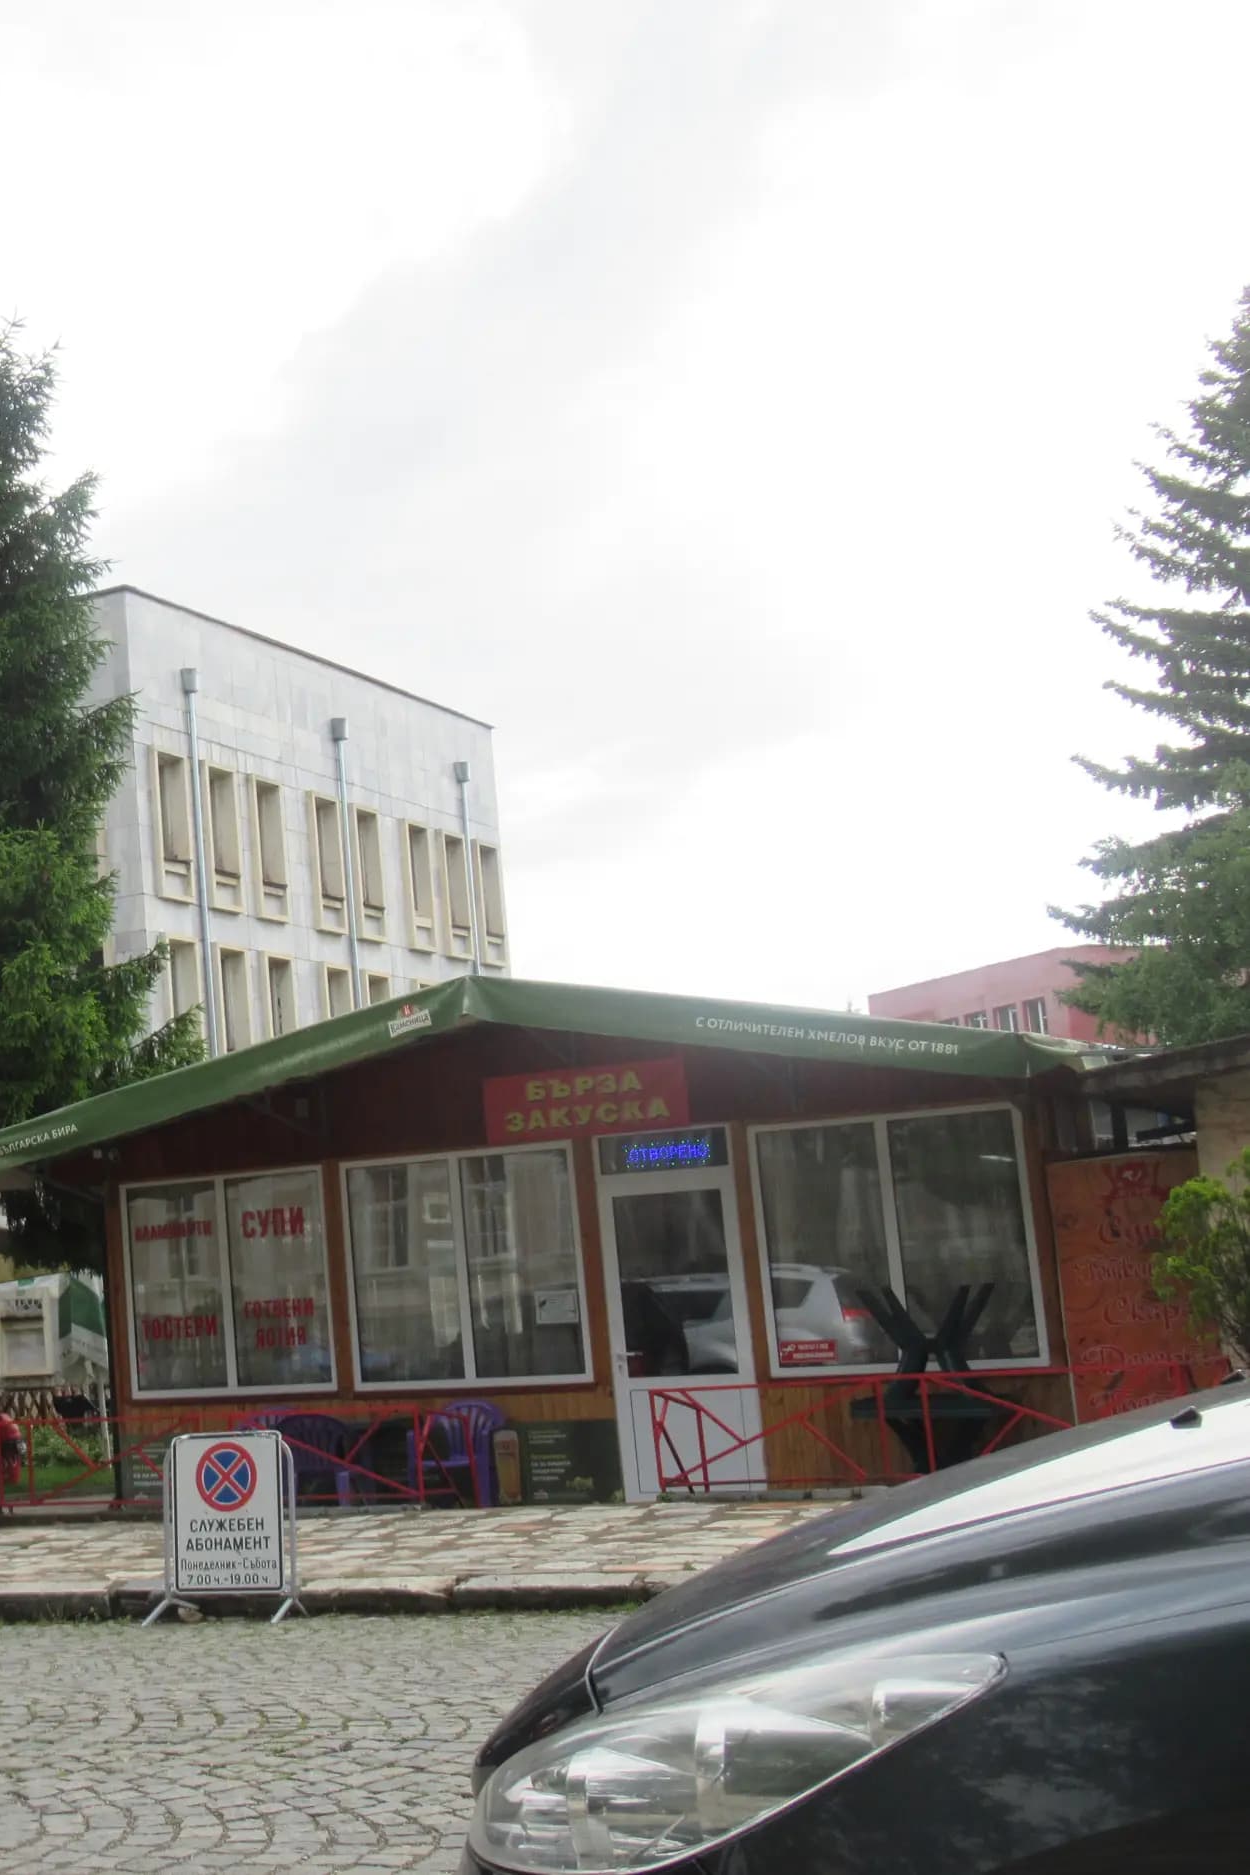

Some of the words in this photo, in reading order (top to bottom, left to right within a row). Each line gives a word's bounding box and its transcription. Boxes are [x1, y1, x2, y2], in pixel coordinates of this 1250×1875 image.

[695, 1016, 706, 1028] С
[707, 1017, 805, 1040] ОТЛИЧИТЕЛЕН
[807, 1028, 866, 1046] ХМЕЛОВ
[869, 1035, 906, 1050] ВКУС
[907, 1039, 929, 1053] ОТ
[930, 1042, 959, 1055] 1881
[525, 1070, 643, 1102] БЪРЗА
[505, 1097, 671, 1132] ЗАКУСКА
[51, 1123, 79, 1139] БИРА
[627, 1142, 711, 1162] ОТВОРЕНО
[240, 1205, 305, 1239] СУПИ
[141, 1313, 219, 1340] ТОСТЕРИ
[189, 1517, 265, 1533] СЛУЖЕБЕН
[185, 1536, 271, 1552] АБОНАМЕНТ
